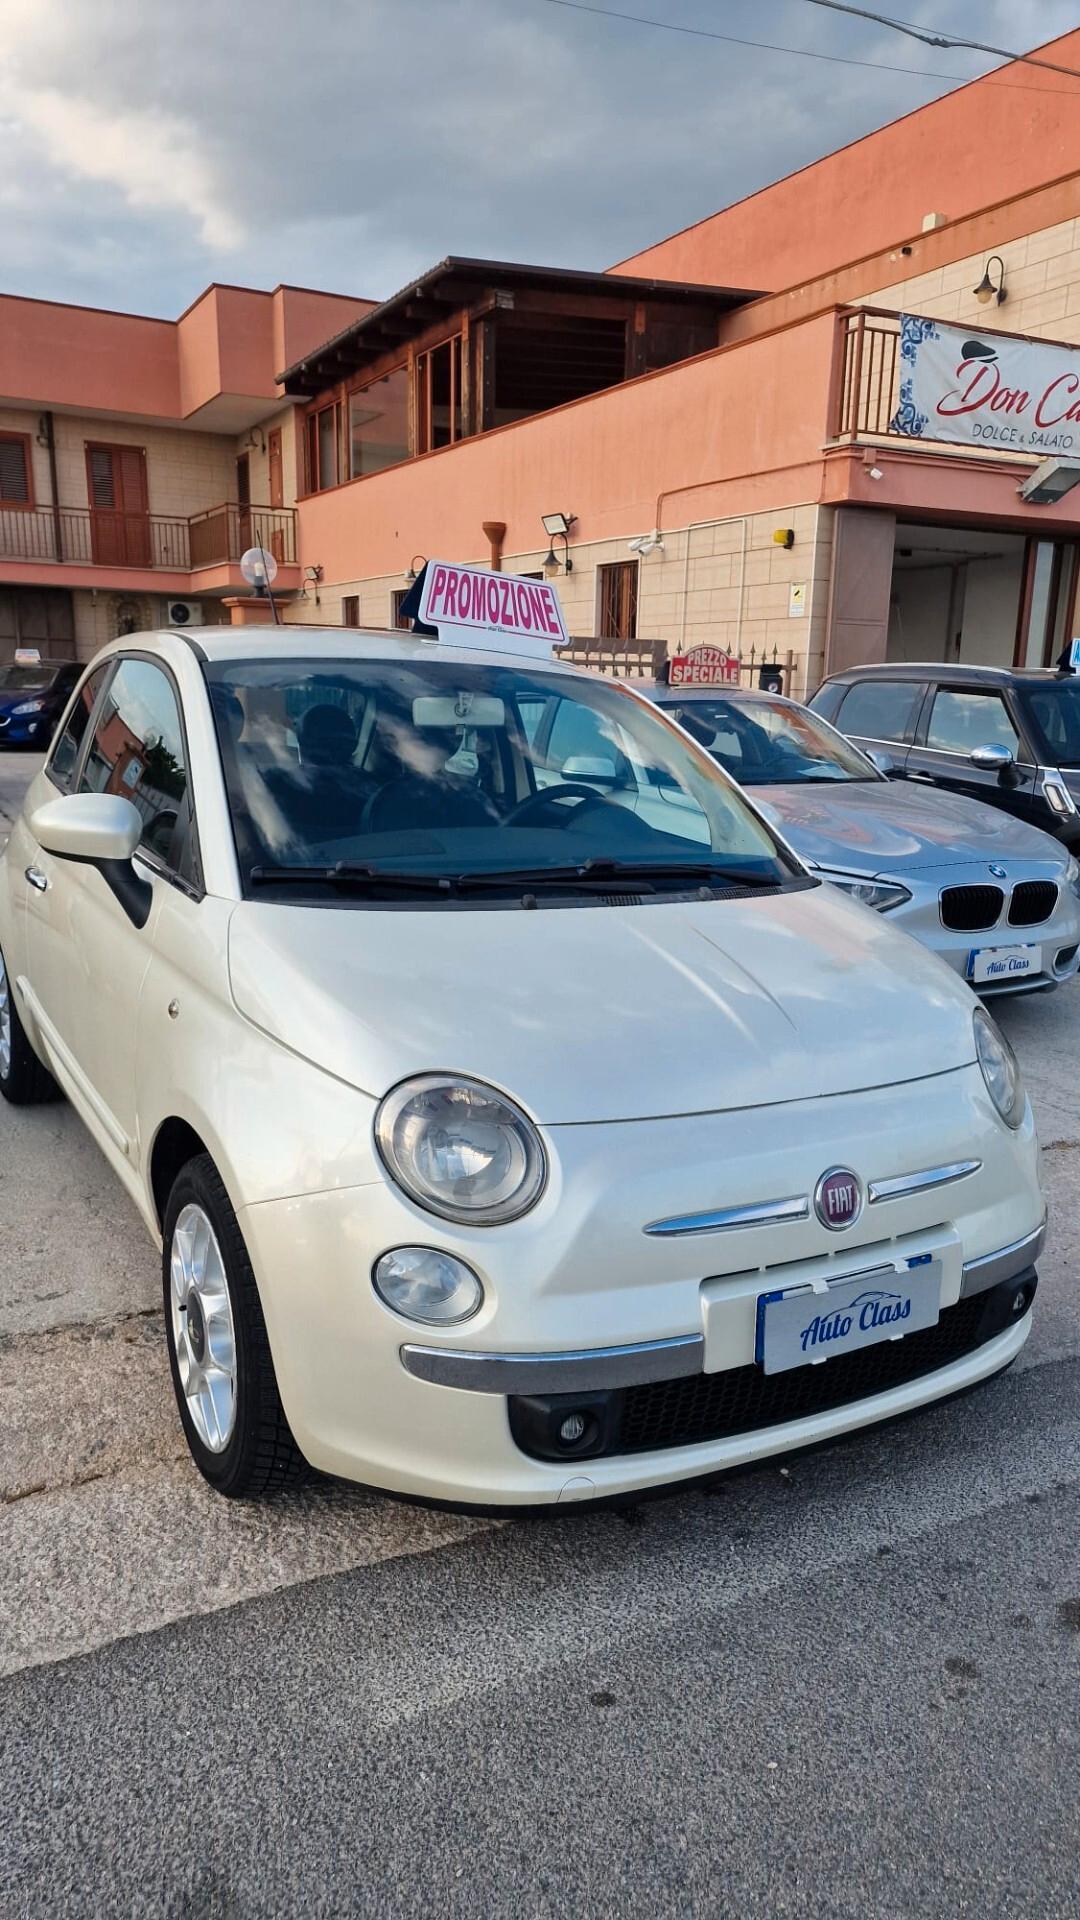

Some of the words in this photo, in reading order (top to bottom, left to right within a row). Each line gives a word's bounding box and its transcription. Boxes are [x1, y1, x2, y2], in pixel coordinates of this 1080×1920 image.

[936, 359, 1032, 416] Don
[972, 423, 1018, 442] DOLCE
[1028, 431, 1073, 449] SALATO
[429, 568, 560, 634] PROMOZIONE
[687, 648, 727, 667] PREZZO
[673, 665, 738, 684] SPECIALE
[986, 961, 1006, 975] Auto
[1008, 958, 1030, 971] Class
[827, 1184, 854, 1216] FIAT
[800, 1313, 853, 1351] Auto
[858, 1299, 911, 1331] Class
